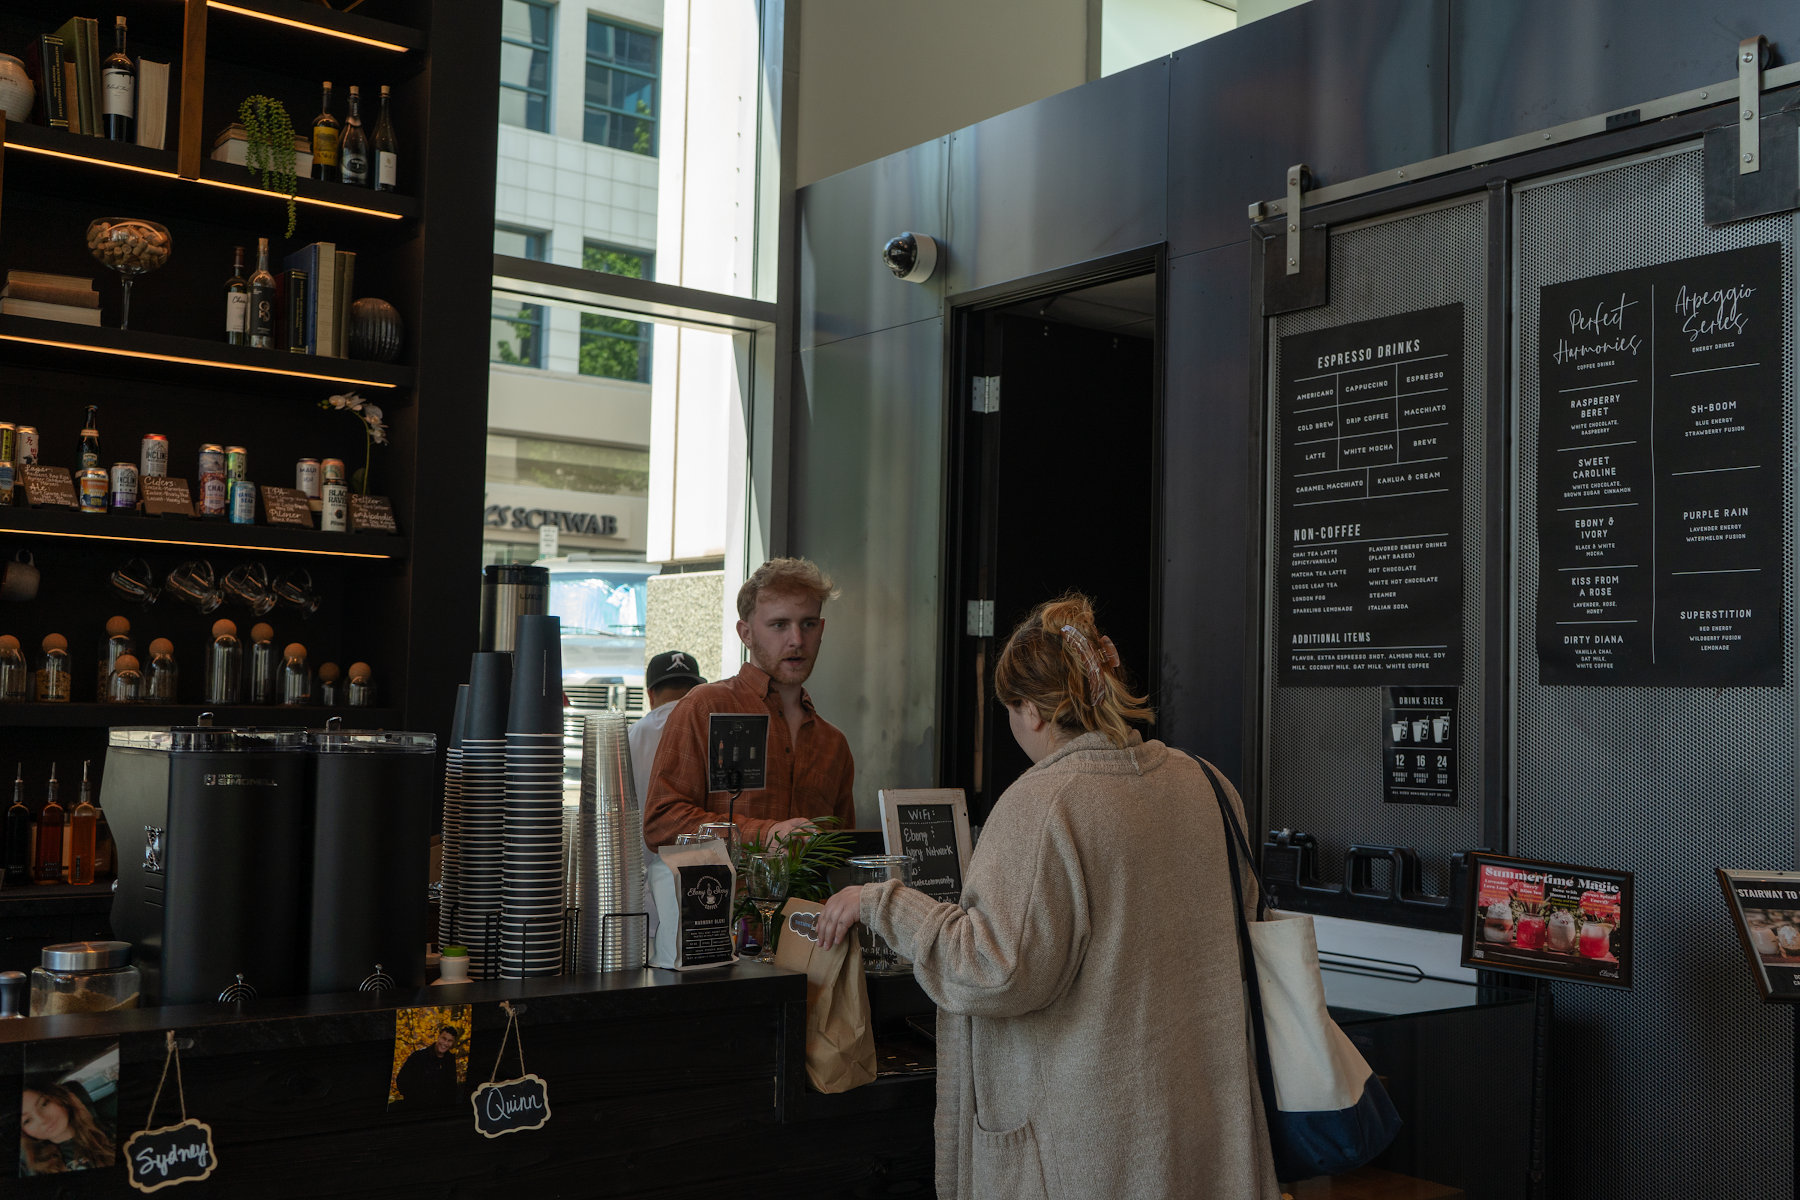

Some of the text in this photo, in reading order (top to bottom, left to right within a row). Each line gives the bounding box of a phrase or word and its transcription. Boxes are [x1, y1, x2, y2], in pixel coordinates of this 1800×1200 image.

[1675, 284, 1756, 321] Arpeggio
[1569, 293, 1638, 335] Perfect
[1682, 311, 1748, 342] Series
[1553, 335, 1642, 364] Harmonies
[1692, 342, 1735, 353] ENERGY DRINKS
[1318, 339, 1420, 369] ESPRESSO DRINKS
[1406, 372, 1444, 383] ESPRESSO
[1345, 380, 1388, 392] CAPPUCCINO
[1297, 389, 1333, 400] AMERICANO
[1571, 394, 1620, 408] RASPBERRY
[1404, 405, 1446, 416] MACCHIATO
[1581, 407, 1609, 418] BERET
[1691, 401, 1736, 414] SH-BOOM
[1364, 413, 1389, 422] COFFEE
[1711, 417, 1733, 425] ENERGY
[1315, 421, 1333, 430] BREW
[1581, 428, 1610, 436] RASPBERRY
[1685, 428, 1722, 437] STRAWBERRY
[1414, 438, 1437, 446] BREVE
[1344, 444, 1393, 455] WHITE MOCHA
[1306, 452, 1326, 460] LATTE
[1578, 456, 1610, 467] SWEET
[1573, 467, 1616, 479] CAROLINE
[1378, 476, 1405, 484] KAHLUA
[1296, 480, 1363, 493] CARAMEL MACCHIATO
[1683, 508, 1749, 520] PURPLE RAIN
[512, 507, 618, 535] SCHWAB
[1575, 517, 1614, 528] EBONY &
[1294, 524, 1361, 541] NON-COFFEE
[1581, 530, 1608, 539] IVORY
[1383, 565, 1416, 573] CHOCOLATE
[1572, 576, 1619, 585] KISS FROM
[1579, 587, 1612, 597] A ROSE
[1680, 609, 1751, 620] SUPERSTITION
[1292, 632, 1370, 644] ADDITIONAL ITEMS
[1564, 635, 1623, 644] DIRTY DIANA
[1399, 697, 1444, 705] DRINK SIZES
[1395, 754, 1405, 767] 12
[1417, 755, 1425, 767] 16
[1437, 756, 1447, 768] 24
[904, 828, 928, 846] Ebony
[1485, 867, 1619, 893] Summertime Magic
[1785, 891, 1797, 899] TO
[487, 1088, 542, 1121] Quinn
[136, 1143, 209, 1176] Sydney
